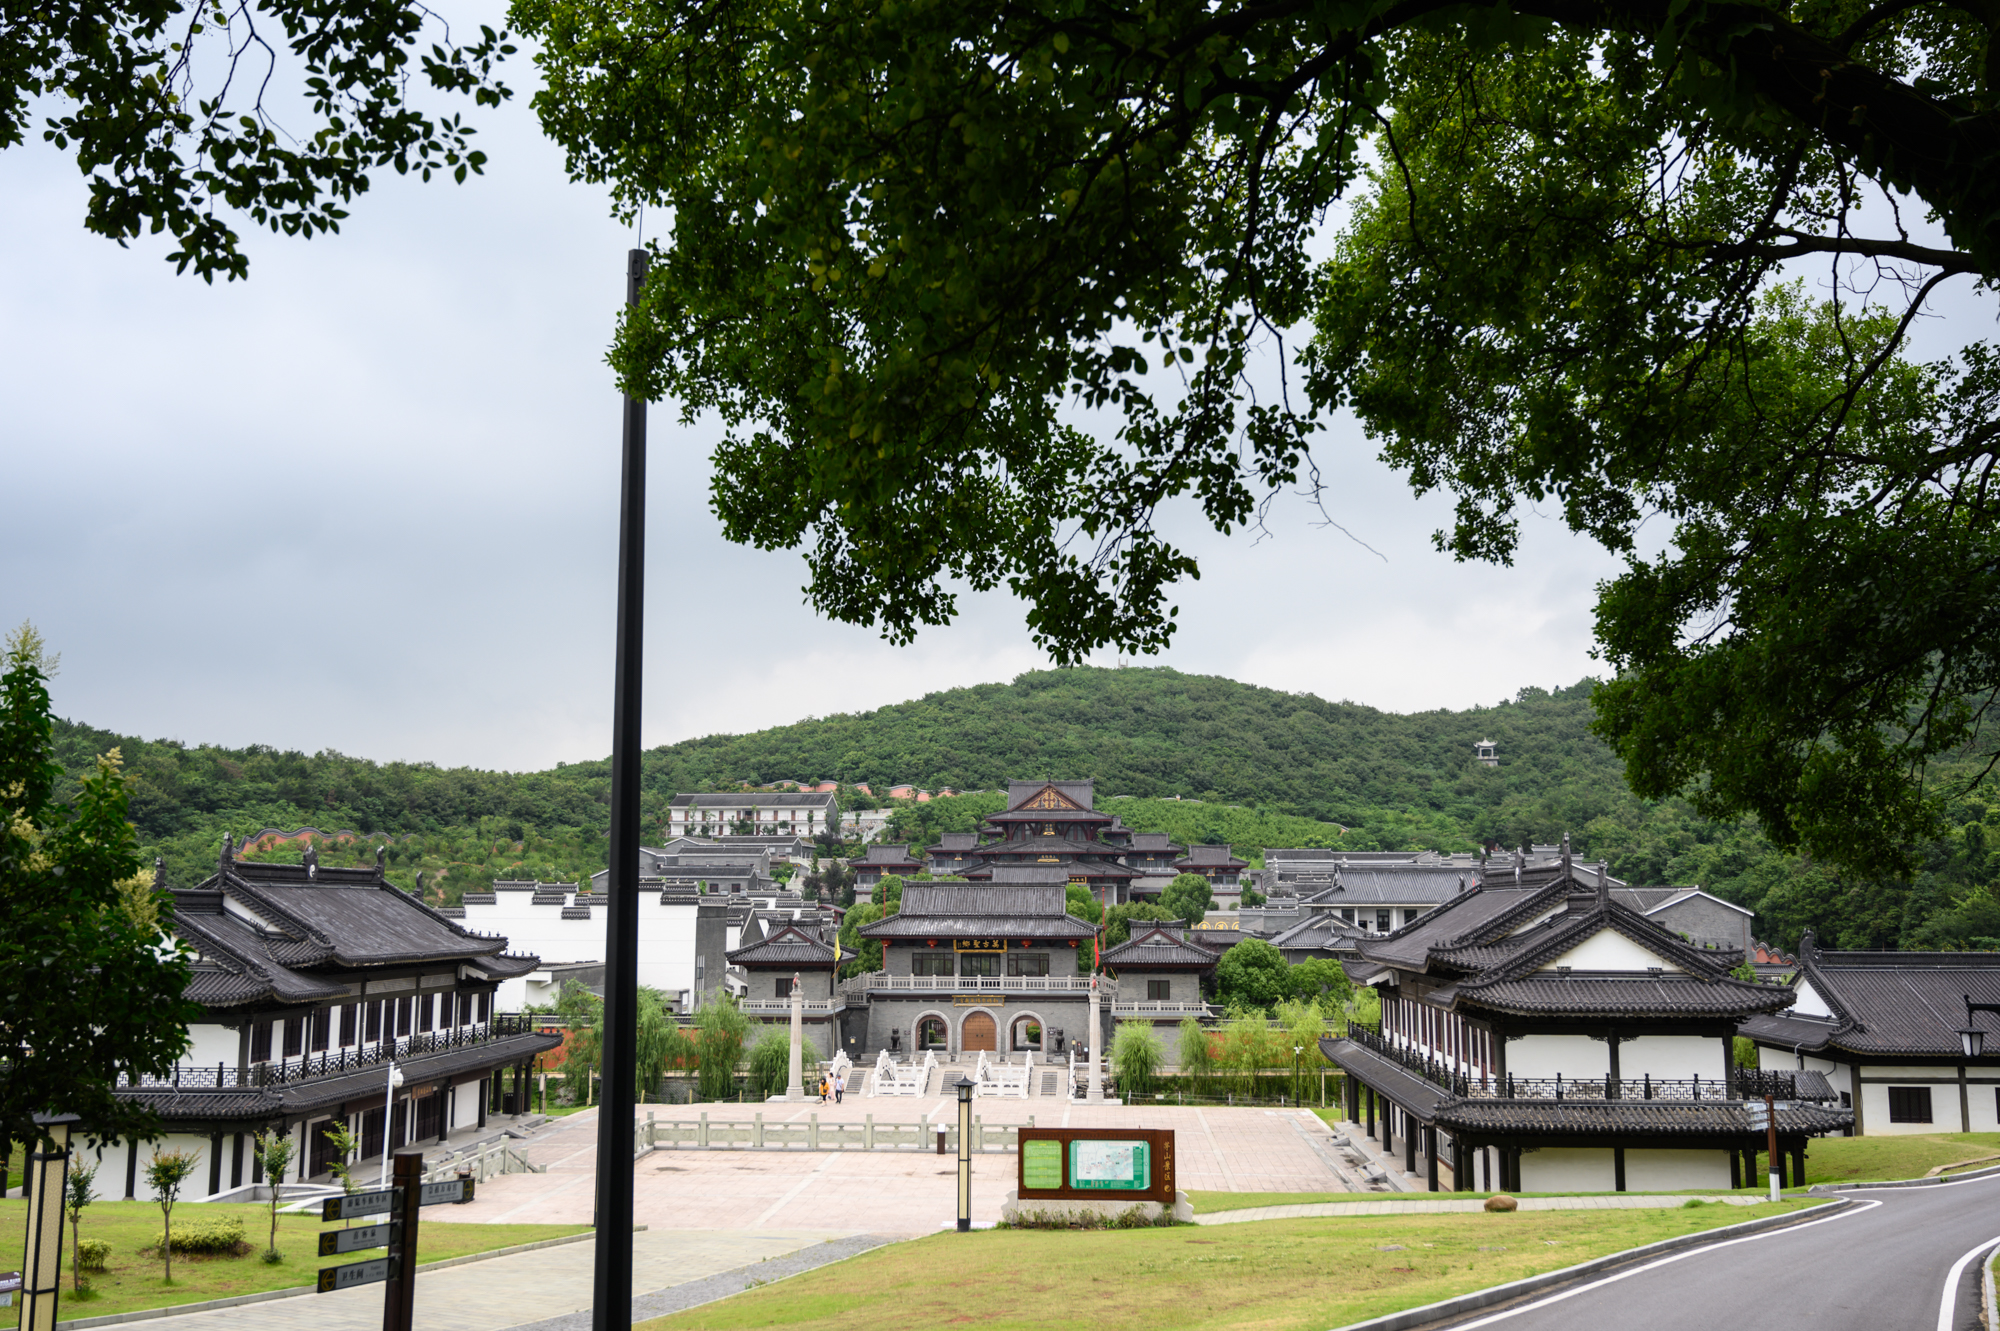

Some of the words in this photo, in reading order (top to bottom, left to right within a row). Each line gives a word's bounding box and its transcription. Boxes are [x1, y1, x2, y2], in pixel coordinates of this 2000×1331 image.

[1163, 1141, 1171, 1181] 茅山景区
[341, 1268, 364, 1282] 卫生间
